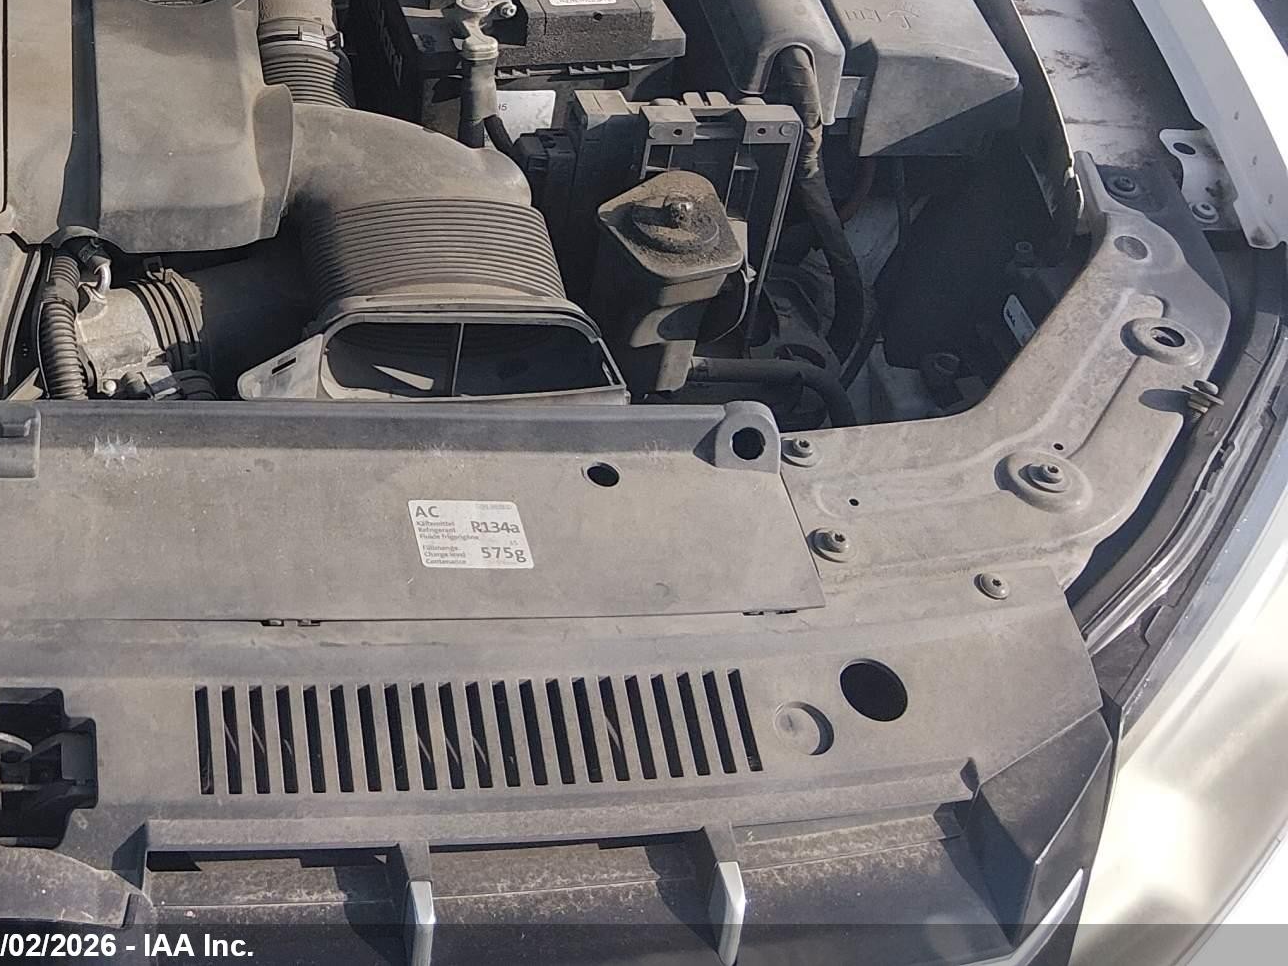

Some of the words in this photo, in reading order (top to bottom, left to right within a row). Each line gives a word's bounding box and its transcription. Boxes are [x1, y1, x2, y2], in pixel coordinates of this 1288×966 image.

[415, 506, 440, 518] AC
[470, 520, 520, 534] R134a
[481, 546, 527, 563] 575g
